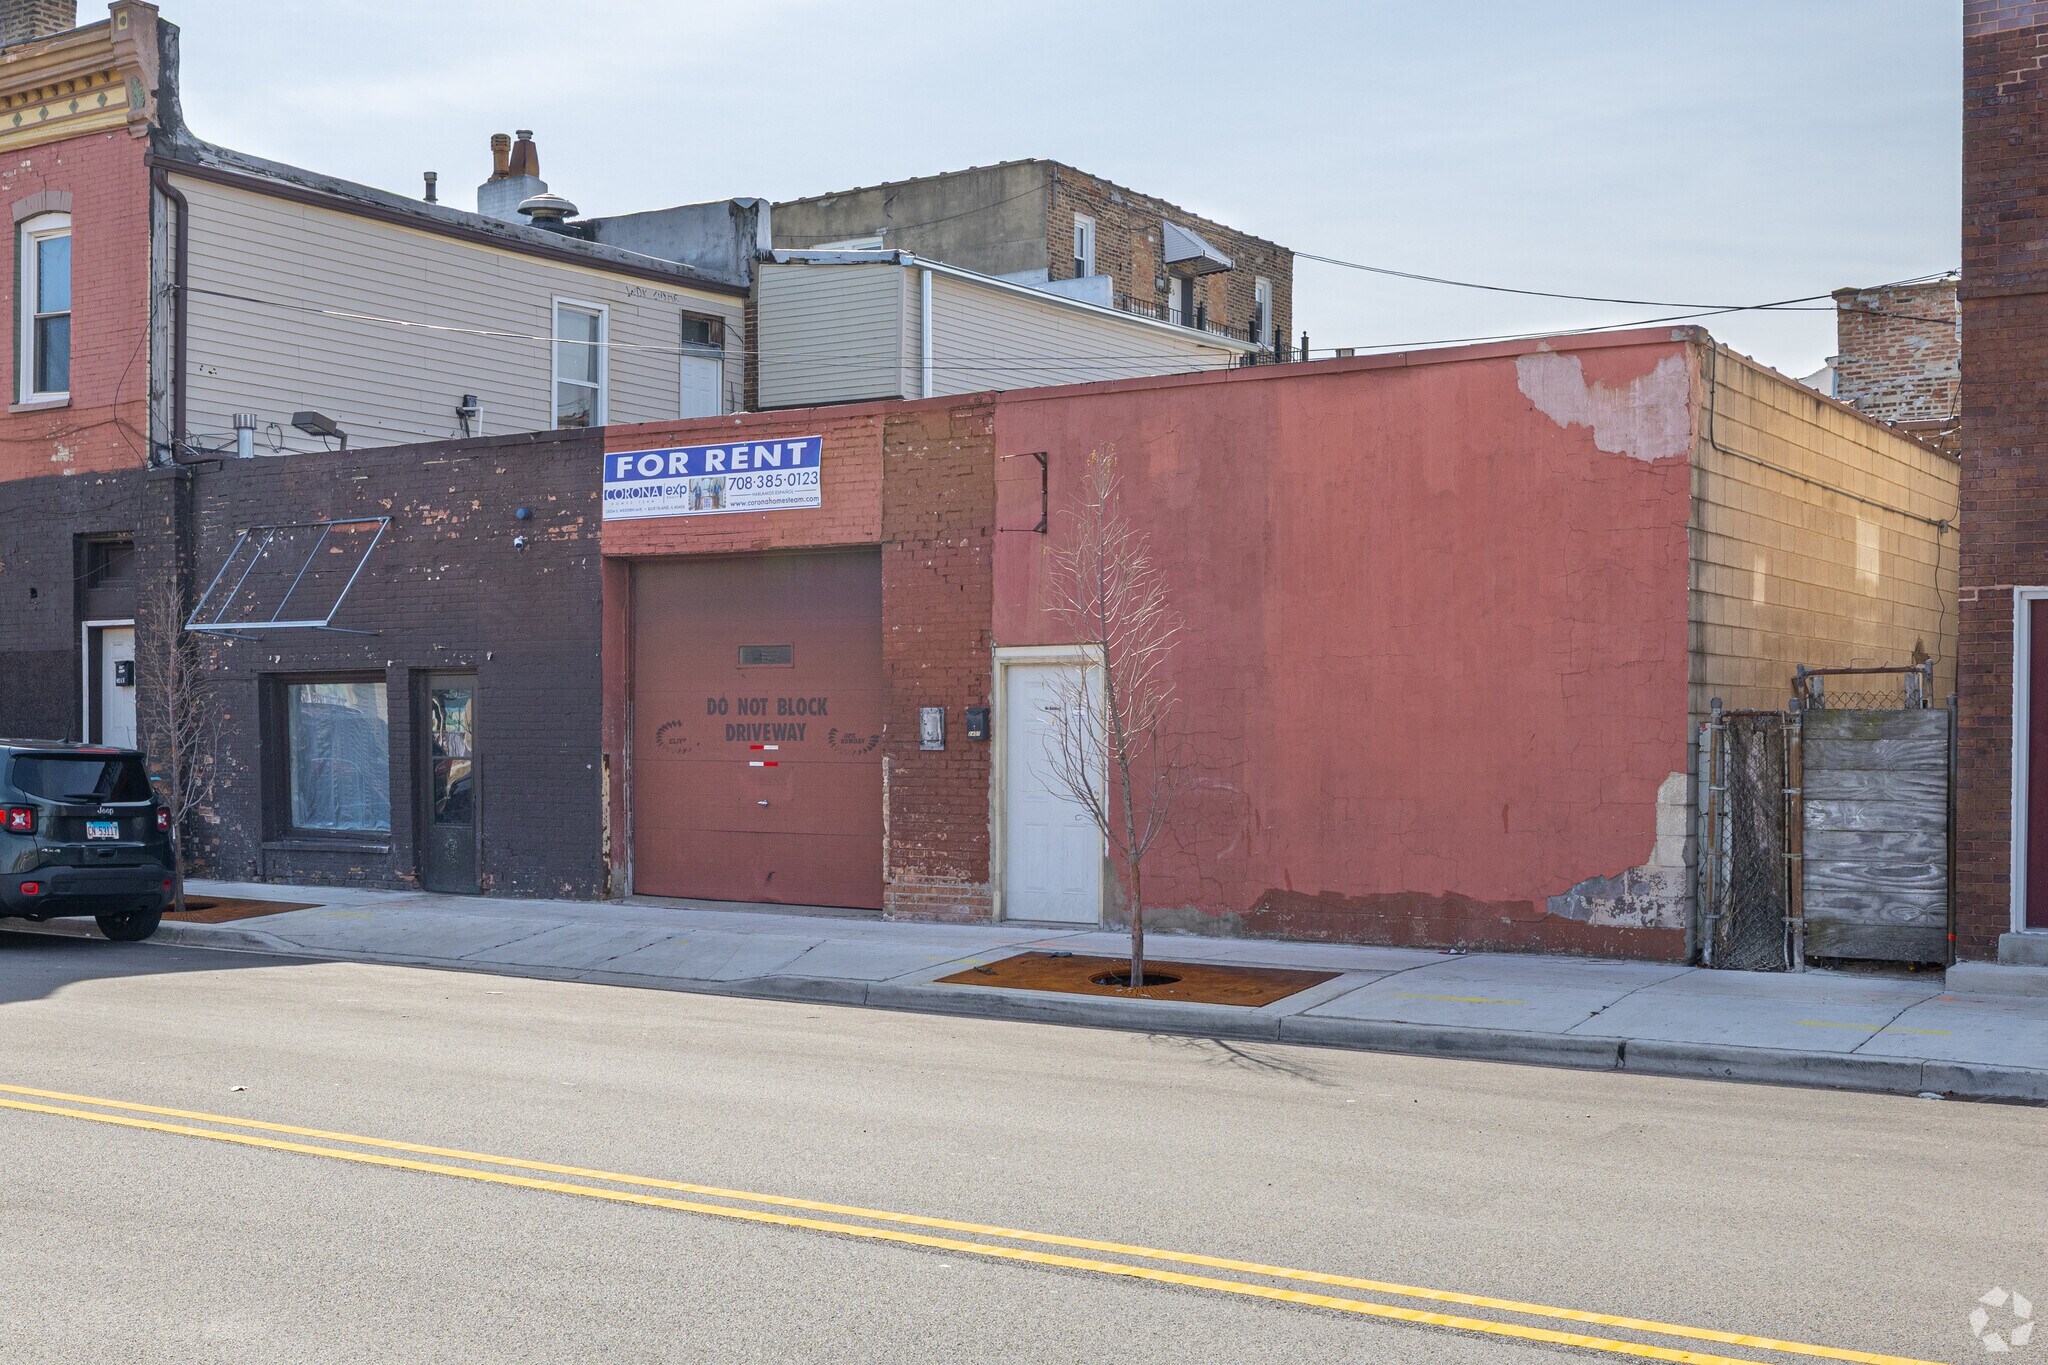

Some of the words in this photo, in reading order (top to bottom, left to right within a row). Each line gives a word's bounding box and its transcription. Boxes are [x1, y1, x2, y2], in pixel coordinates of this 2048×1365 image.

[616, 451, 689, 478] FOR
[704, 441, 808, 473] RENT
[605, 486, 662, 500] CORONA
[665, 483, 687, 499] exp
[730, 496, 819, 507] www.coronahomesteam.com
[706, 697, 729, 716] DO
[737, 697, 768, 716] NOT
[777, 697, 829, 716] BLOCK
[725, 722, 807, 742] DRIVEWAY
[97, 806, 114, 815] Jeep
